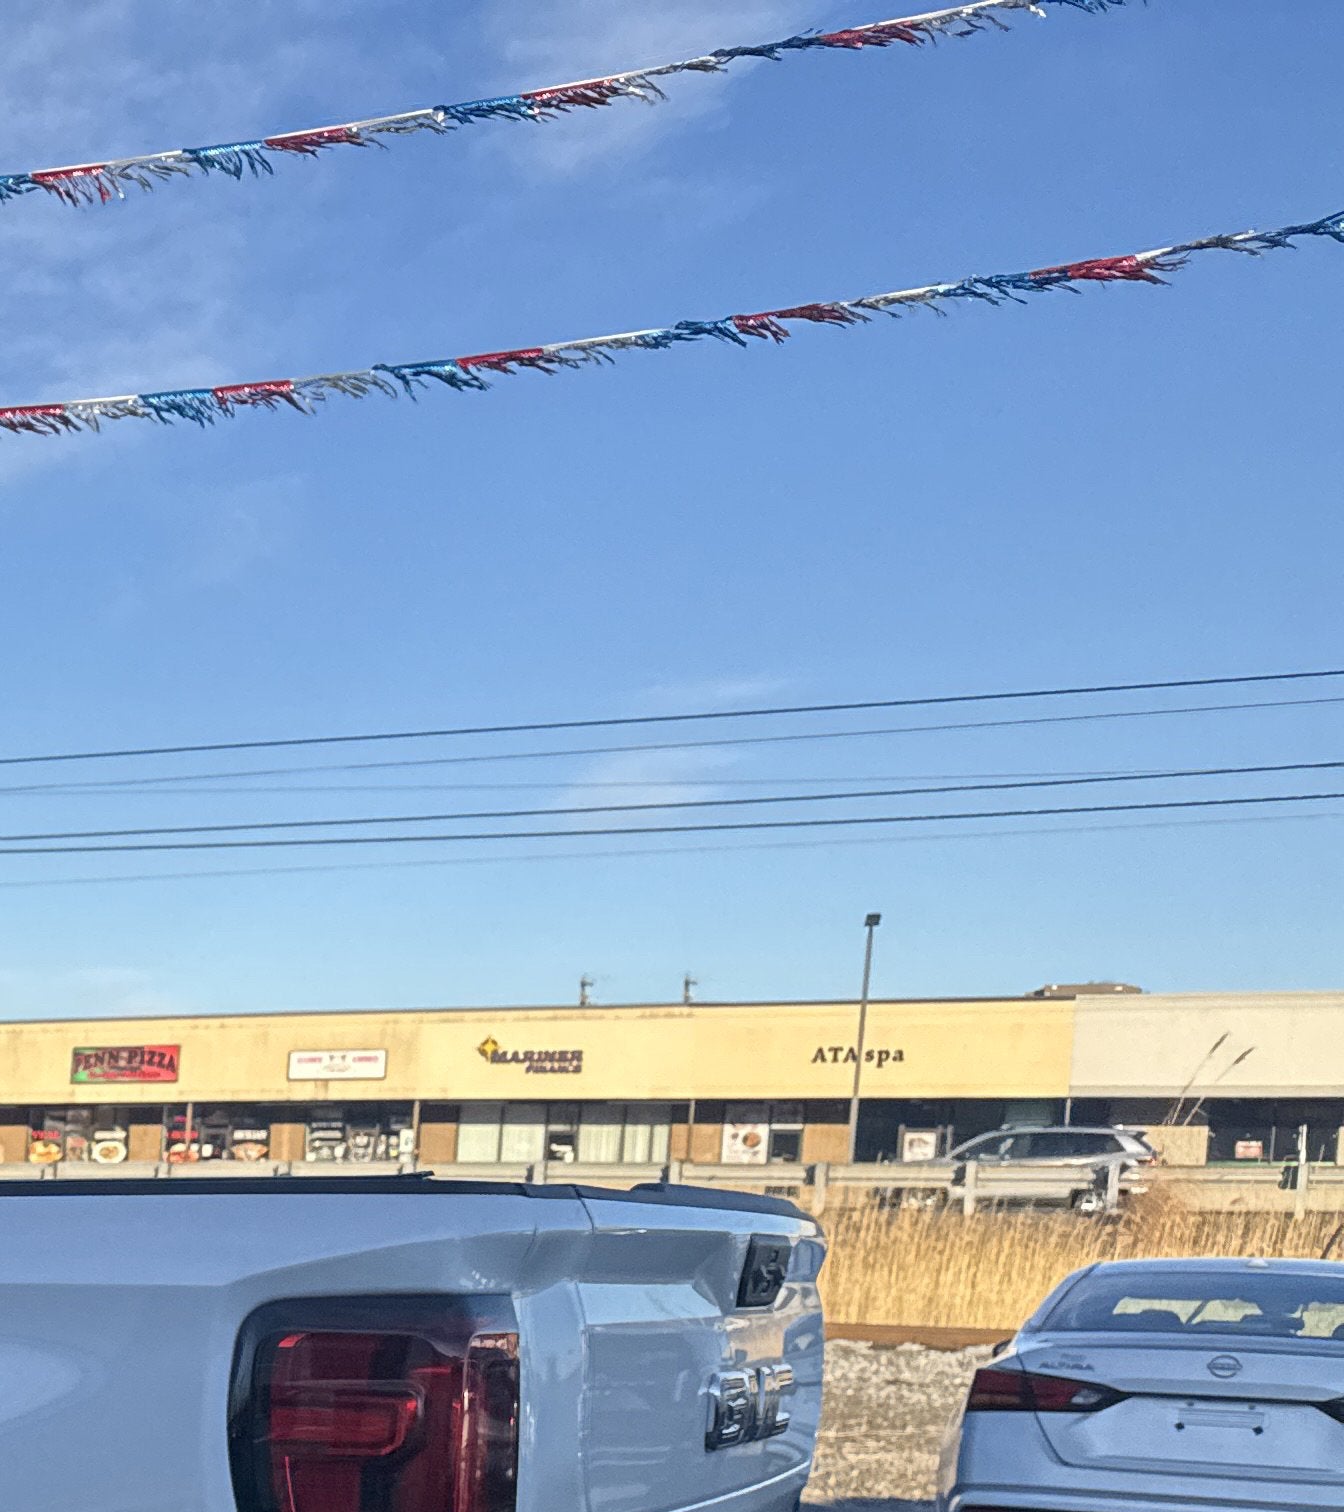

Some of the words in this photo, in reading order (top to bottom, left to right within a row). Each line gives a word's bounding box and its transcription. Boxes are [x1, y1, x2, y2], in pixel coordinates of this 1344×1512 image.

[127, 1049, 177, 1073] PIZZA
[491, 1050, 582, 1062] MARINER
[811, 1046, 858, 1063] ATA
[864, 1049, 904, 1068] spa
